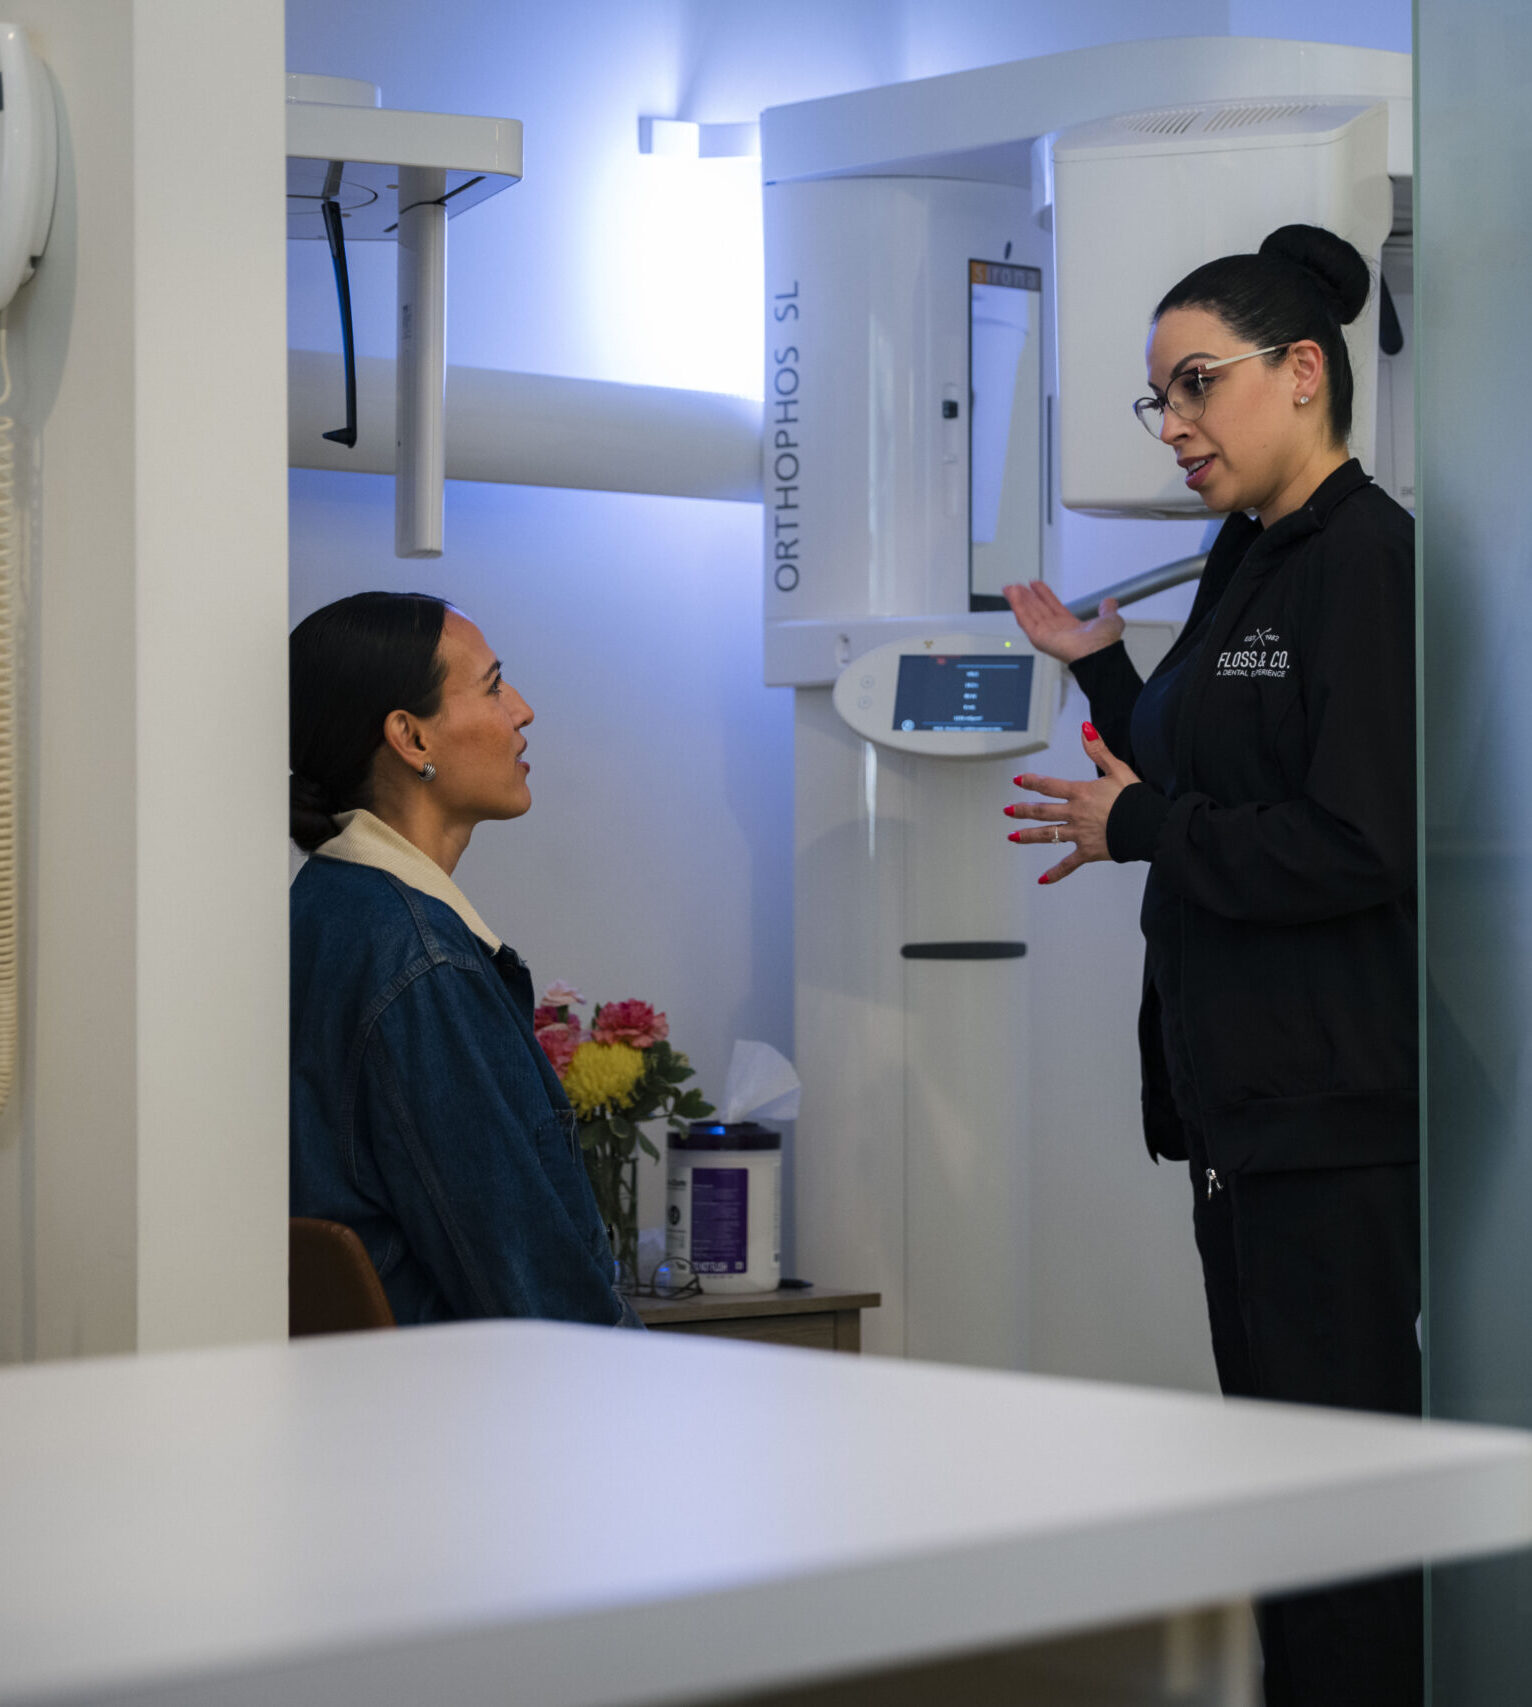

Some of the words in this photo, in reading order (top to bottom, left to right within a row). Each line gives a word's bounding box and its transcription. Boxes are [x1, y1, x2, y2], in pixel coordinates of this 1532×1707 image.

[775, 281, 799, 322] SL
[774, 346, 799, 592] ORTHOPHOS
[1217, 650, 1258, 668] FLOSS
[1258, 651, 1266, 667] &
[1269, 650, 1290, 669] CO.
[1251, 669, 1286, 677] EPERIENCE
